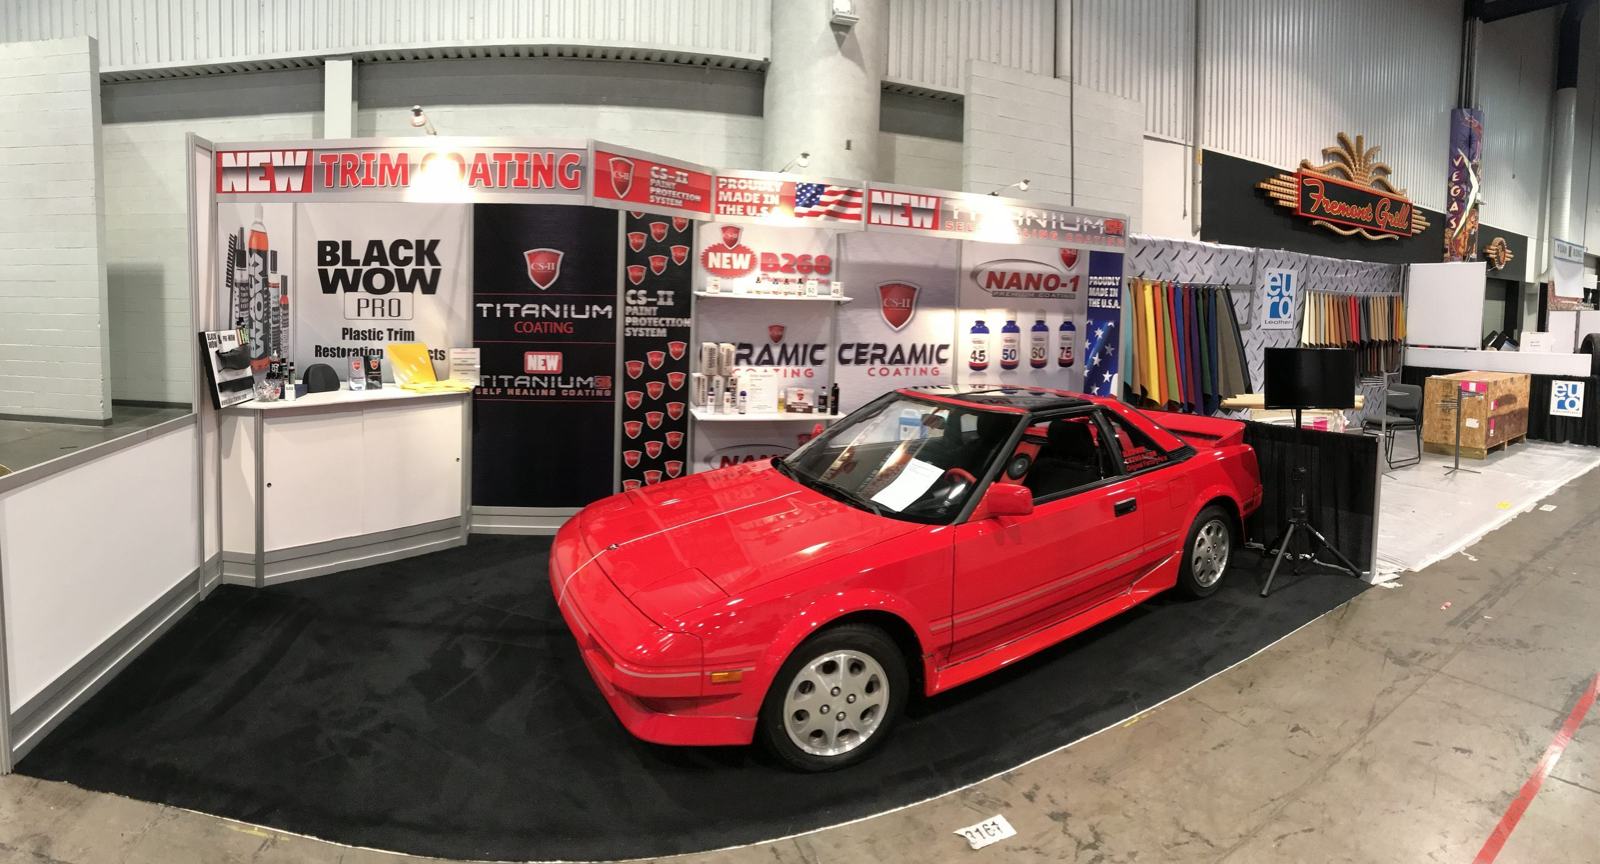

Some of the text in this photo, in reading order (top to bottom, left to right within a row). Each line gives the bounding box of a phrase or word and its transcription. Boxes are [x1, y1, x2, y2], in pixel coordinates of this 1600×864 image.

[222, 151, 581, 192] NEW TRIM ATING
[650, 166, 689, 184] CS-II
[650, 179, 676, 190] PAINT
[649, 186, 701, 202] PROTECTION
[719, 191, 779, 205] MADE IN
[1449, 156, 1464, 229] VEGAS
[649, 195, 683, 206] SYSTEM
[1303, 178, 1410, 229] Fremont Grill
[718, 204, 784, 217] THE U.S.
[870, 191, 937, 228] NEW
[945, 221, 977, 232] SEL
[317, 239, 441, 266] BLACK
[531, 262, 555, 271] CS-II
[708, 252, 832, 276] NEW B268
[318, 268, 442, 294] WOW
[985, 271, 1080, 292] NANO-1
[1088, 276, 1121, 286] PROUDLY
[625, 289, 674, 306] CS-II
[1088, 287, 1119, 297] MADE IN
[356, 297, 402, 317] PRO
[883, 298, 910, 308] CS-II
[1088, 298, 1121, 309] THE U.S.A.
[476, 303, 612, 318] TITANIUM
[625, 306, 658, 316] PAINT
[514, 321, 575, 334] COATING
[625, 317, 692, 327] PROTECTION
[342, 328, 415, 341] Plastic Trim
[625, 327, 667, 337] SYSTEM
[314, 345, 383, 358] Restoration
[838, 343, 950, 366] CERAMIC
[970, 350, 986, 362] 45
[1002, 348, 1017, 360] 50
[1032, 347, 1046, 359] 60
[1059, 346, 1073, 358] 75
[527, 354, 561, 371] NEW
[867, 367, 940, 377] COATING
[475, 387, 612, 397] SELF HEALING COATING
